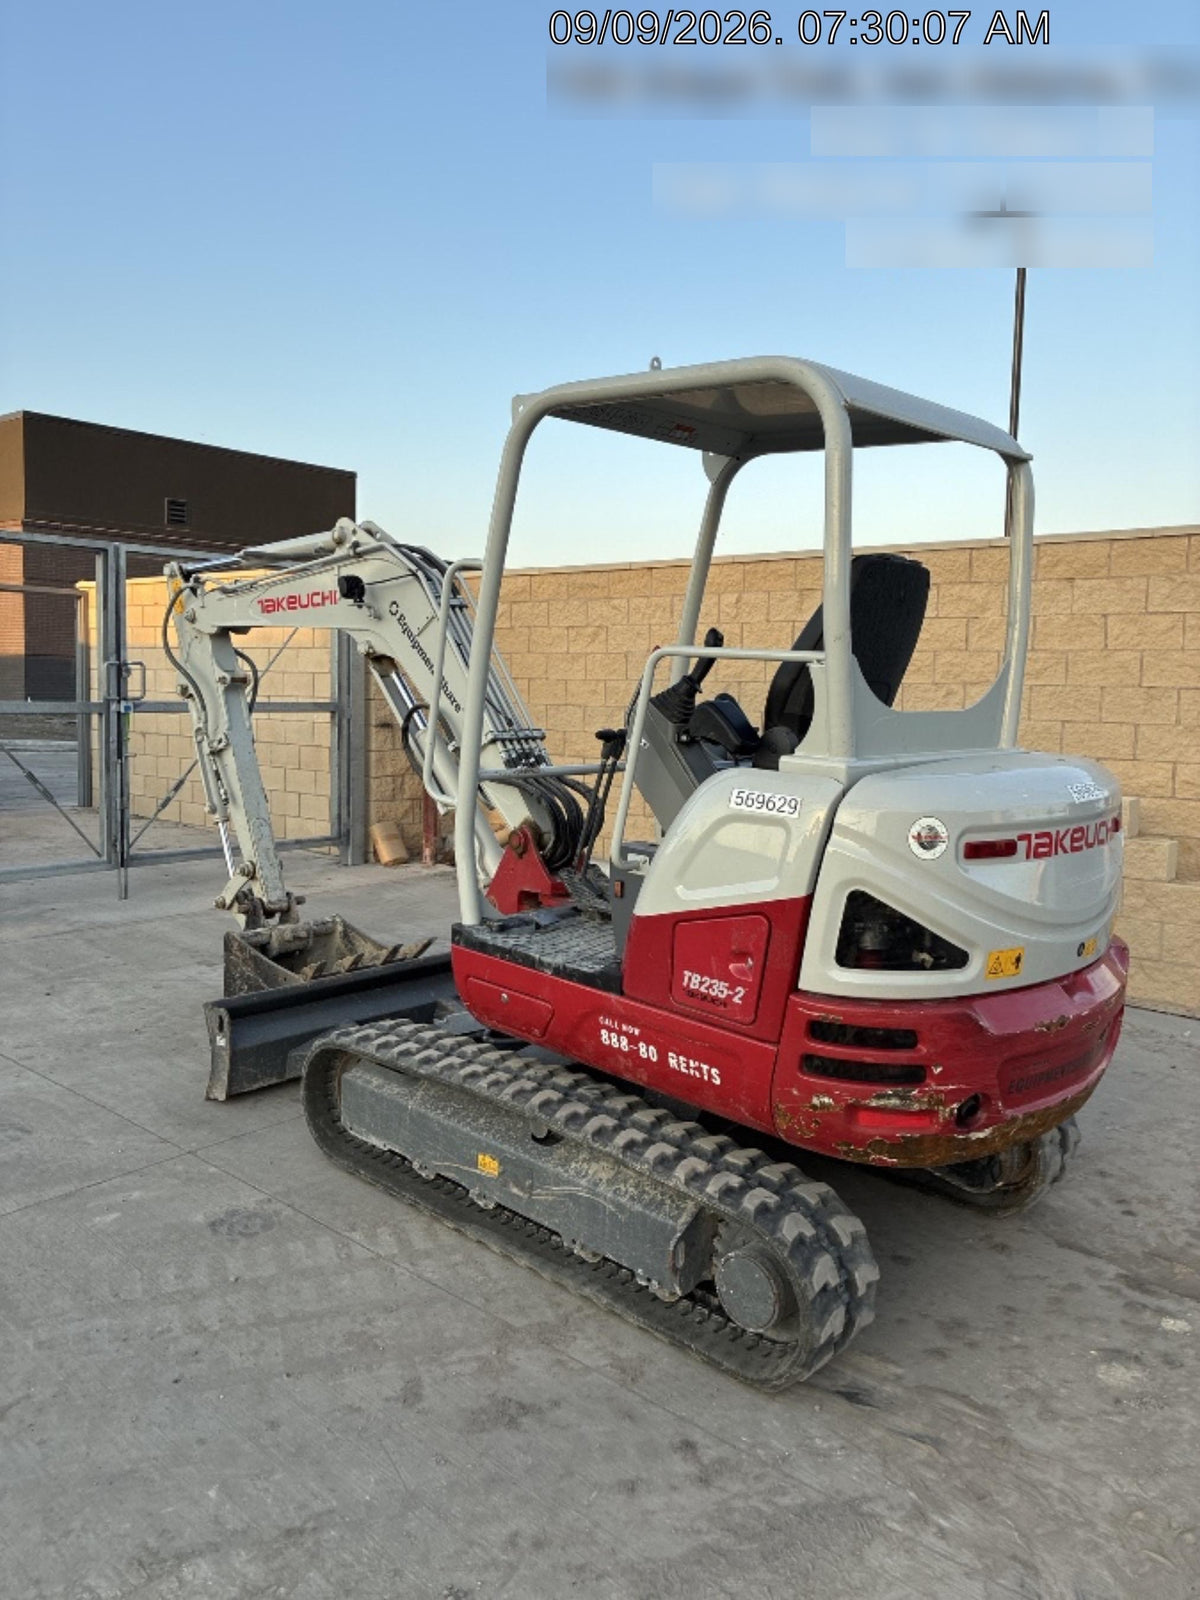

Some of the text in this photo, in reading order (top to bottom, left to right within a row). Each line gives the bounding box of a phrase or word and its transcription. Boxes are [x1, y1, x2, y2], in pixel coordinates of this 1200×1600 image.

[735, 790, 798, 815] 569629
[683, 970, 745, 1004] TB235-2
[599, 1016, 640, 1036] CALL NOW
[600, 1029, 721, 1085] 888-80 RENTS
